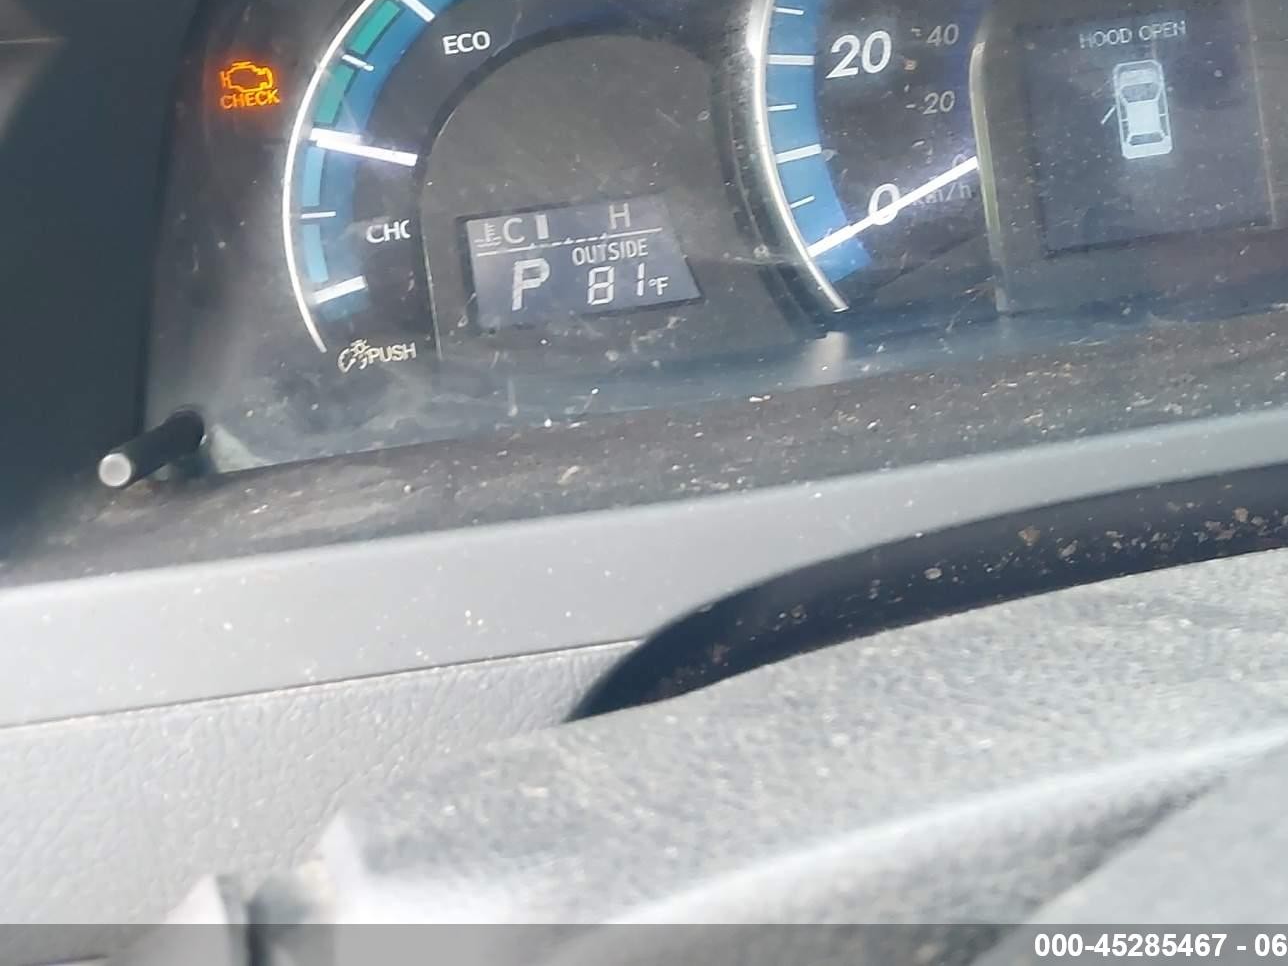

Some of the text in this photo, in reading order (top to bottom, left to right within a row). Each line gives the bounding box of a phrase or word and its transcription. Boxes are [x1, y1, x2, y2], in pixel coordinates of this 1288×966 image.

[442, 31, 491, 56] ECO
[926, 24, 959, 47] 40
[1079, 27, 1132, 48] HOOD
[826, 30, 892, 79] 20
[220, 89, 281, 110] CHECK
[923, 91, 955, 115] 20
[609, 202, 632, 230] H
[868, 183, 900, 225] 0
[571, 238, 649, 267] OUTSIDE
[511, 257, 551, 311] P
[368, 342, 417, 365] PUSH
